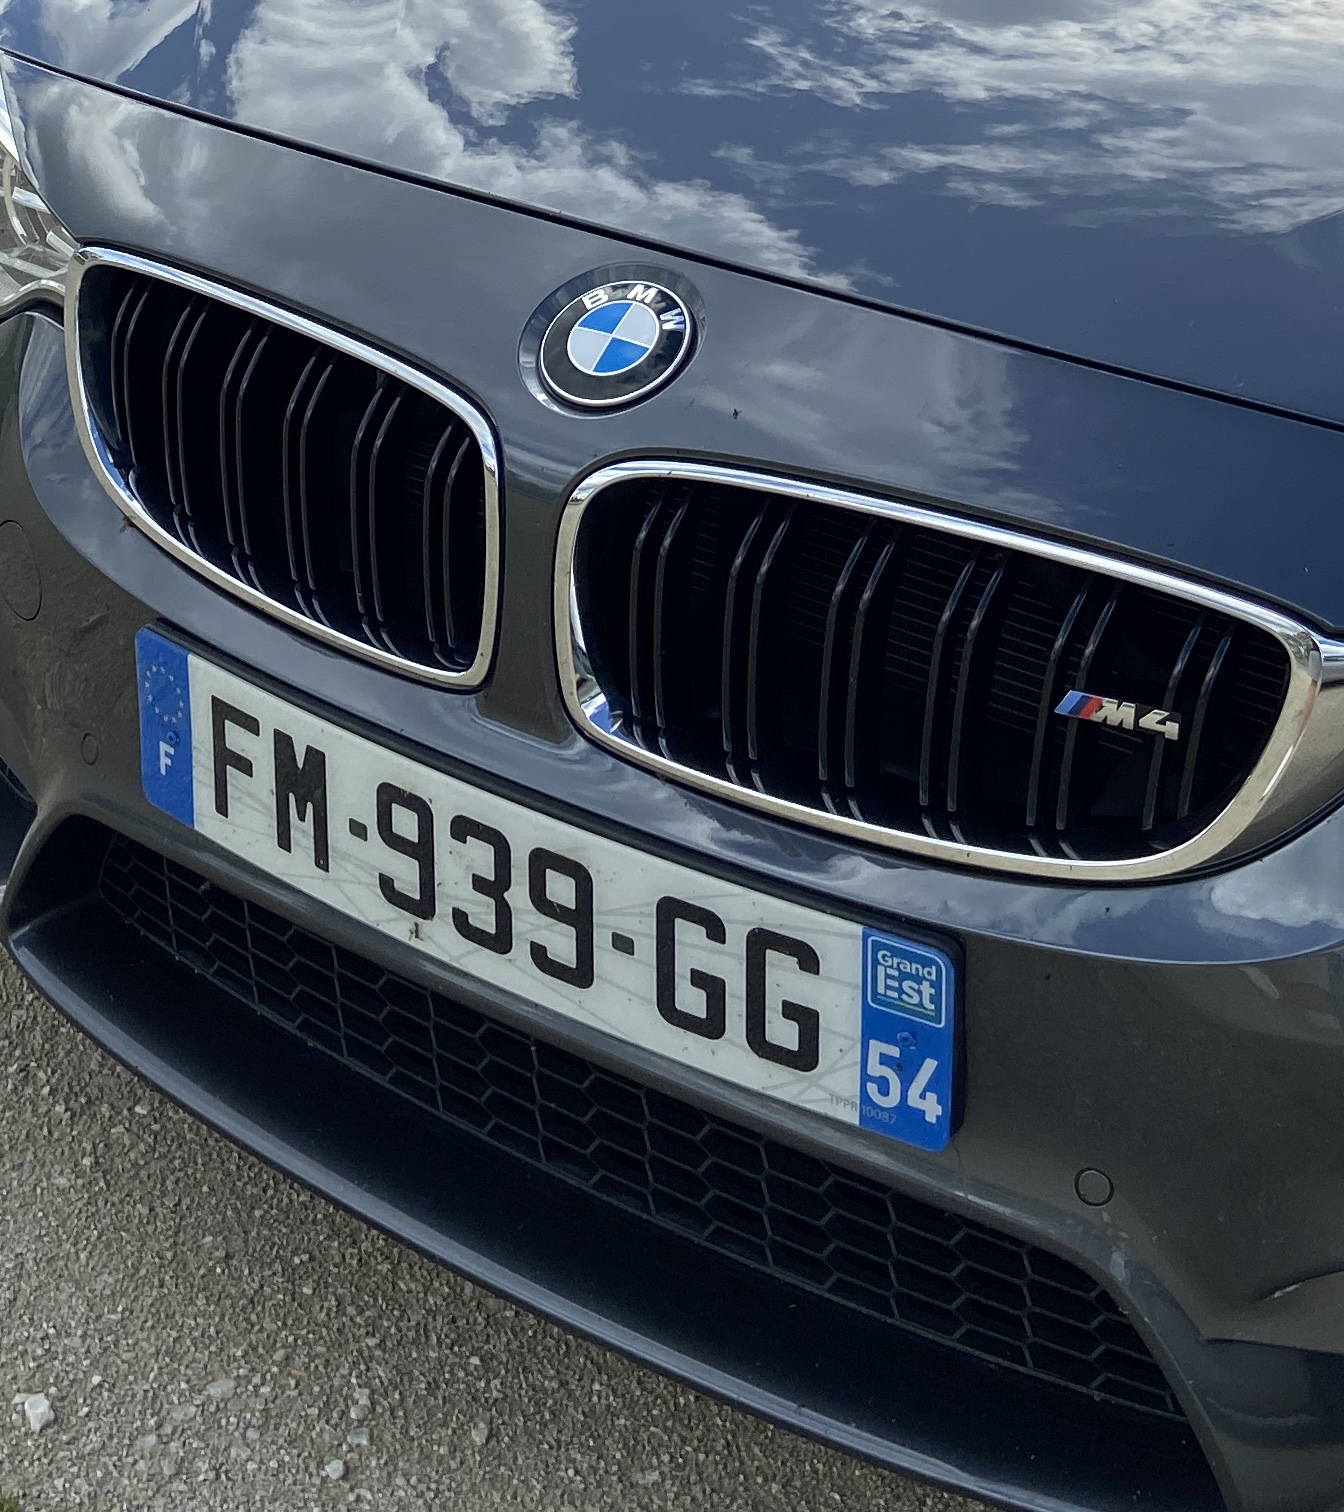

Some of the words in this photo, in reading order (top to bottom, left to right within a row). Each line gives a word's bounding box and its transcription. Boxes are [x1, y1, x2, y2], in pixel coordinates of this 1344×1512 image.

[581, 284, 685, 332] BMW
[1089, 697, 1180, 741] M4
[159, 740, 175, 776] F
[210, 694, 822, 1074] FM-939-GG
[876, 949, 937, 982] Grand
[876, 964, 936, 1011] Est
[866, 1039, 943, 1124] 54
[861, 1104, 897, 1126] 10087
